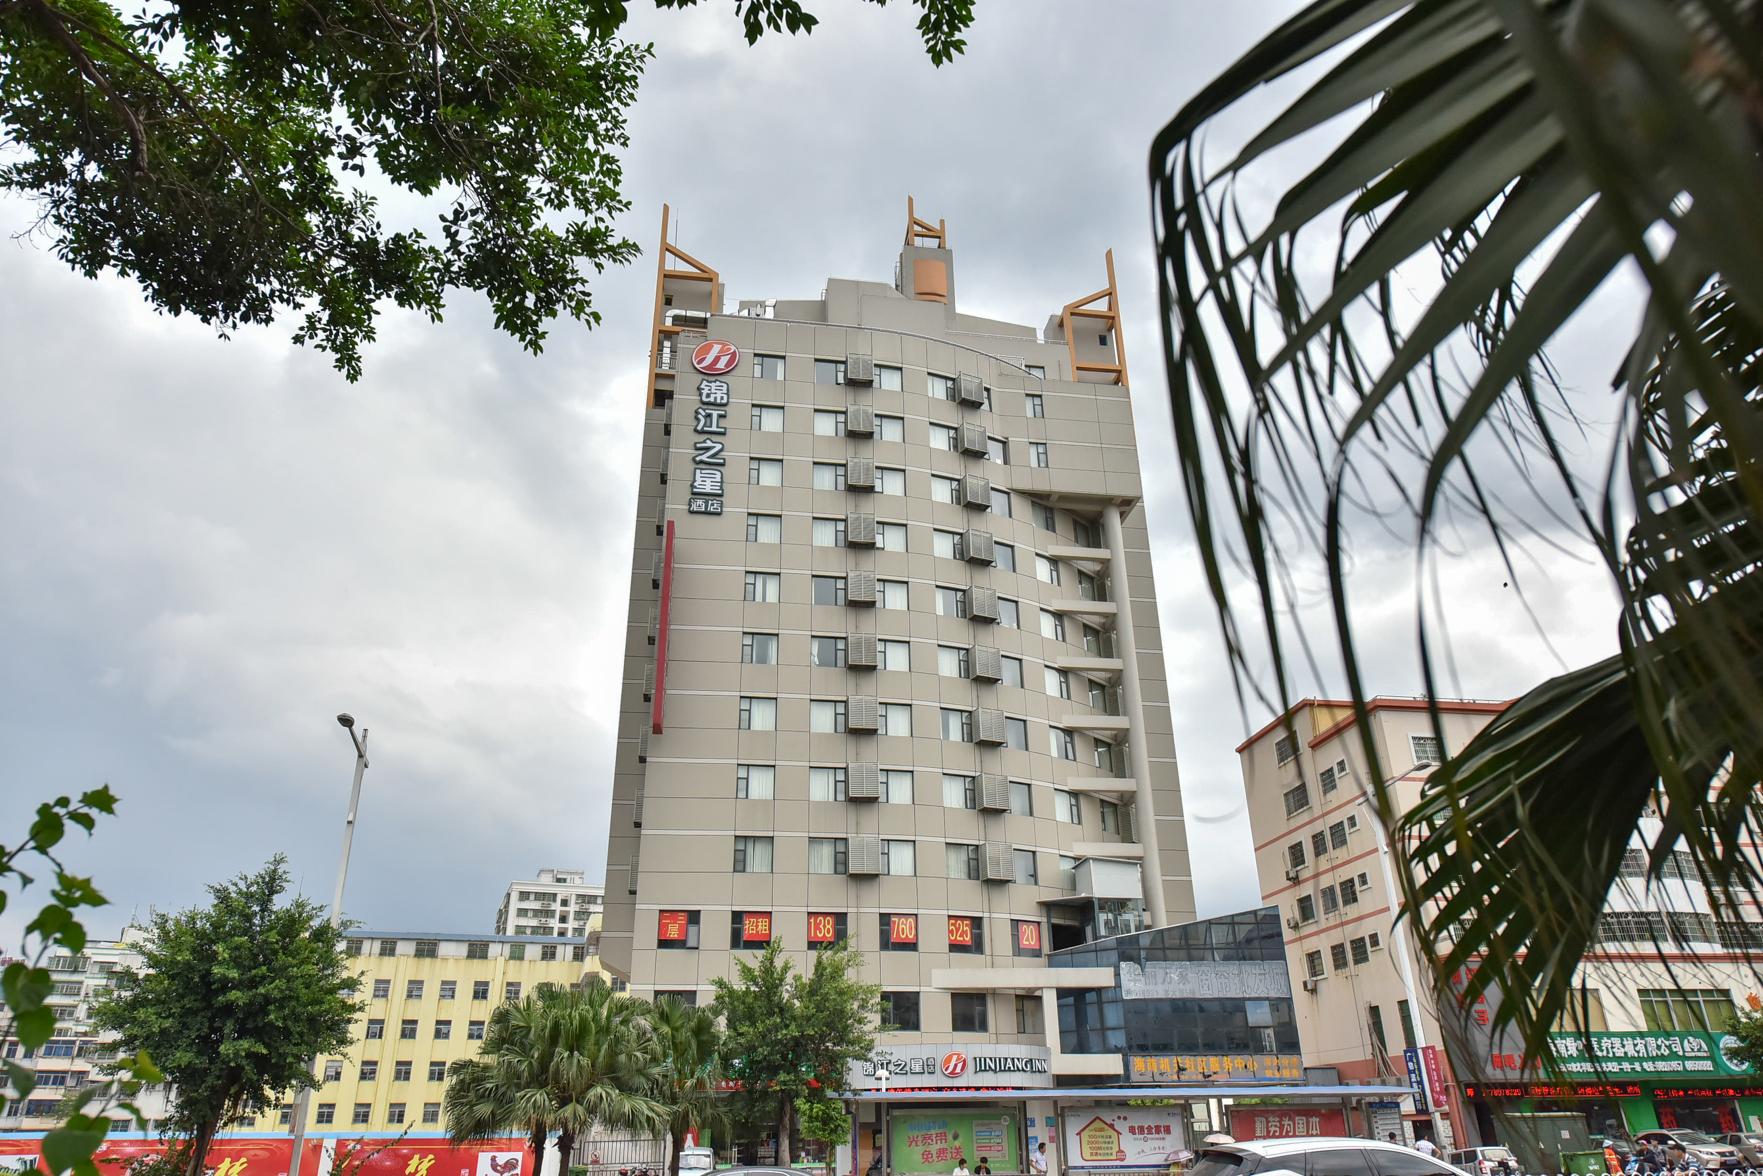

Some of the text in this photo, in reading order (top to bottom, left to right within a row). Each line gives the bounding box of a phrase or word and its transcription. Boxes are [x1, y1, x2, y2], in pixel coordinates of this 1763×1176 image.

[693, 380, 729, 495] 锦江之星
[690, 500, 722, 513] 酒店
[667, 924, 679, 938] 层
[744, 918, 770, 935] 招租
[809, 917, 833, 938] 138
[891, 918, 915, 939] 760
[949, 920, 971, 941] 525
[1022, 925, 1036, 945] 20
[862, 1058, 925, 1076] 锦江之星
[975, 1057, 1048, 1073] JINJIANG INN
[1128, 1124, 1172, 1136] 电信全家福
[1254, 1116, 1320, 1136] 勤劳为国本
[907, 1131, 948, 1147] 光宽带
[921, 1144, 964, 1164] 免费送
